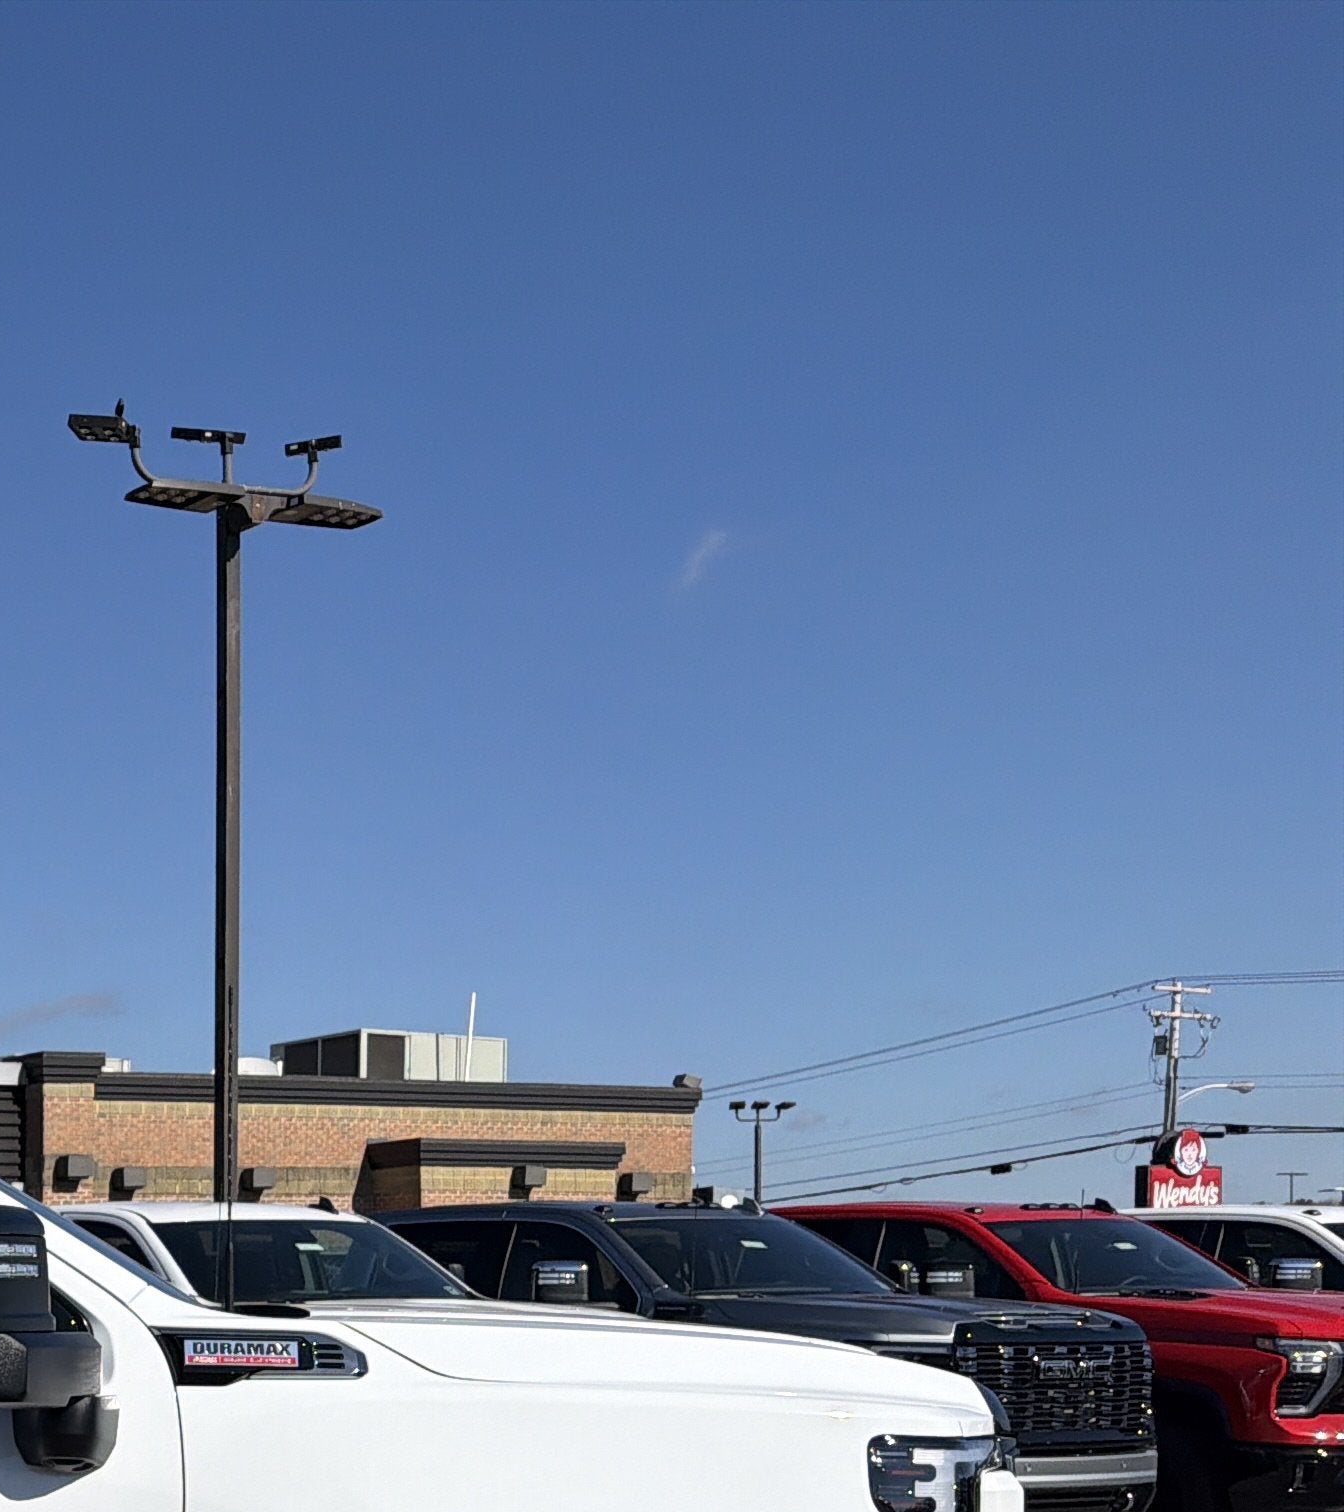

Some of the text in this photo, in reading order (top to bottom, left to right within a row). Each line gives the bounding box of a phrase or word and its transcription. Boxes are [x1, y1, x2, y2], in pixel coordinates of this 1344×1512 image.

[1153, 1175, 1219, 1208] Wendy's
[193, 1341, 292, 1356] DURAMAX
[1039, 1356, 1114, 1381] GMC
